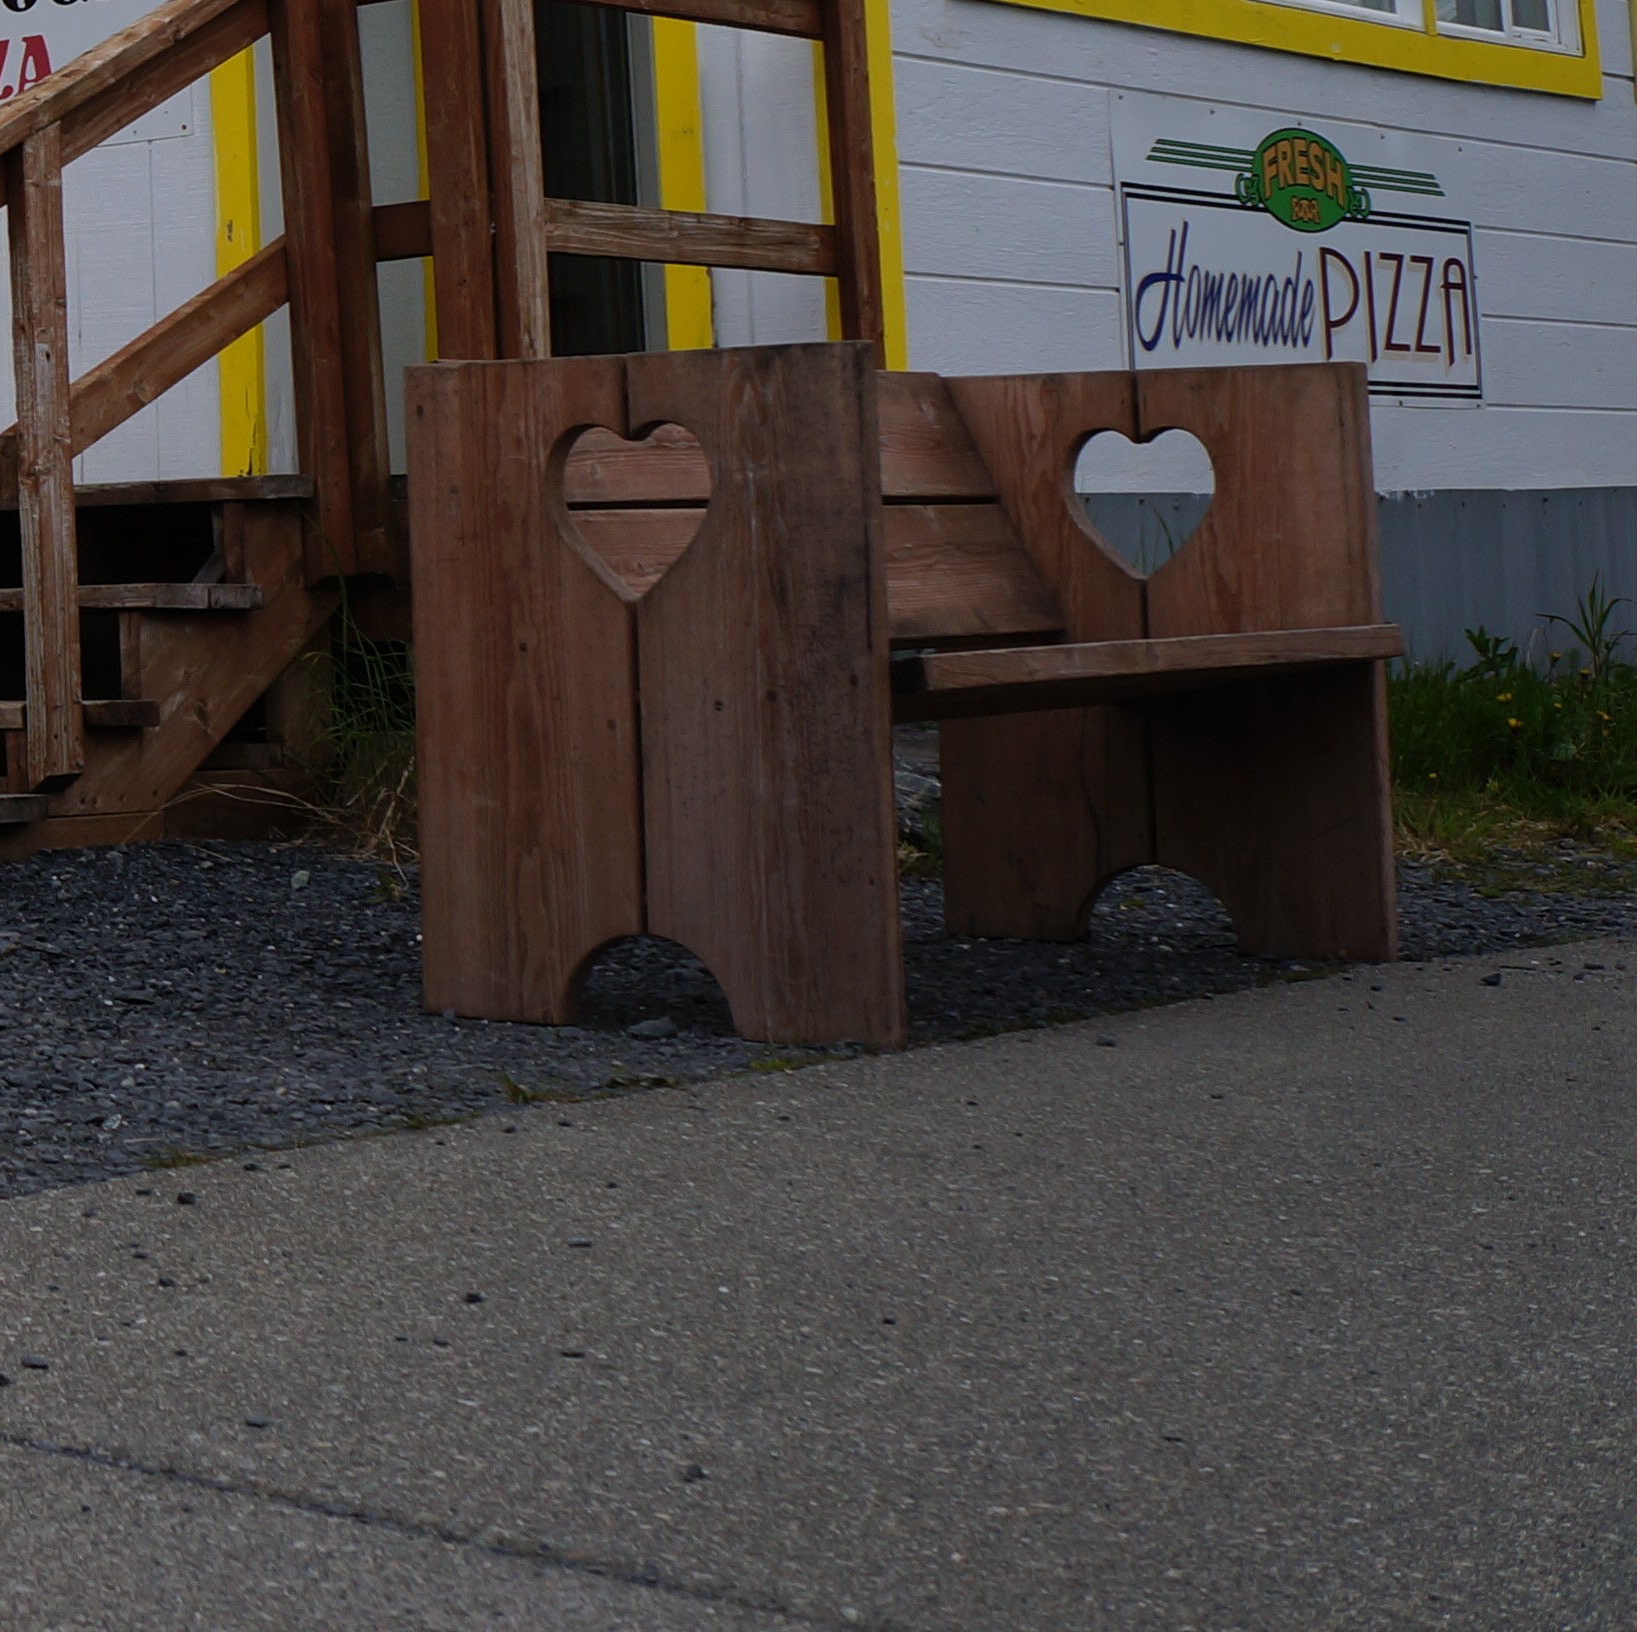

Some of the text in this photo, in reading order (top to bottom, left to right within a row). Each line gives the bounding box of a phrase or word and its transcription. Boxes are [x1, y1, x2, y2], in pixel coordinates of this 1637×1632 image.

[1262, 137, 1346, 210] FRESH
[1135, 221, 1473, 367] Homemade PIZZA
